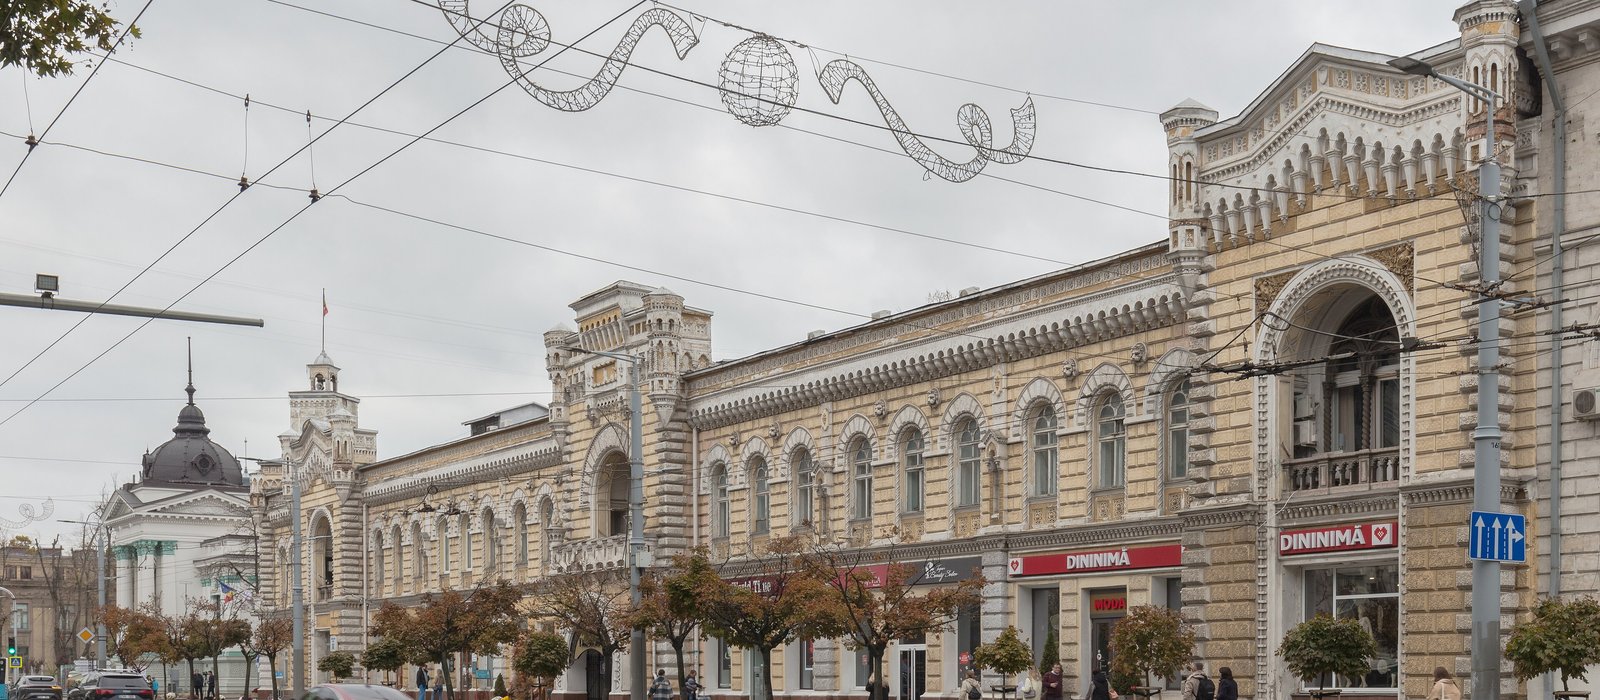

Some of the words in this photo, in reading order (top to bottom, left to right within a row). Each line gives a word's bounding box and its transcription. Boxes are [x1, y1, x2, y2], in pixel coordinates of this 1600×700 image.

[1280, 525, 1366, 551] DININIMĂ
[1066, 546, 1130, 569] DININIMĂ
[1093, 597, 1126, 611] MODA
